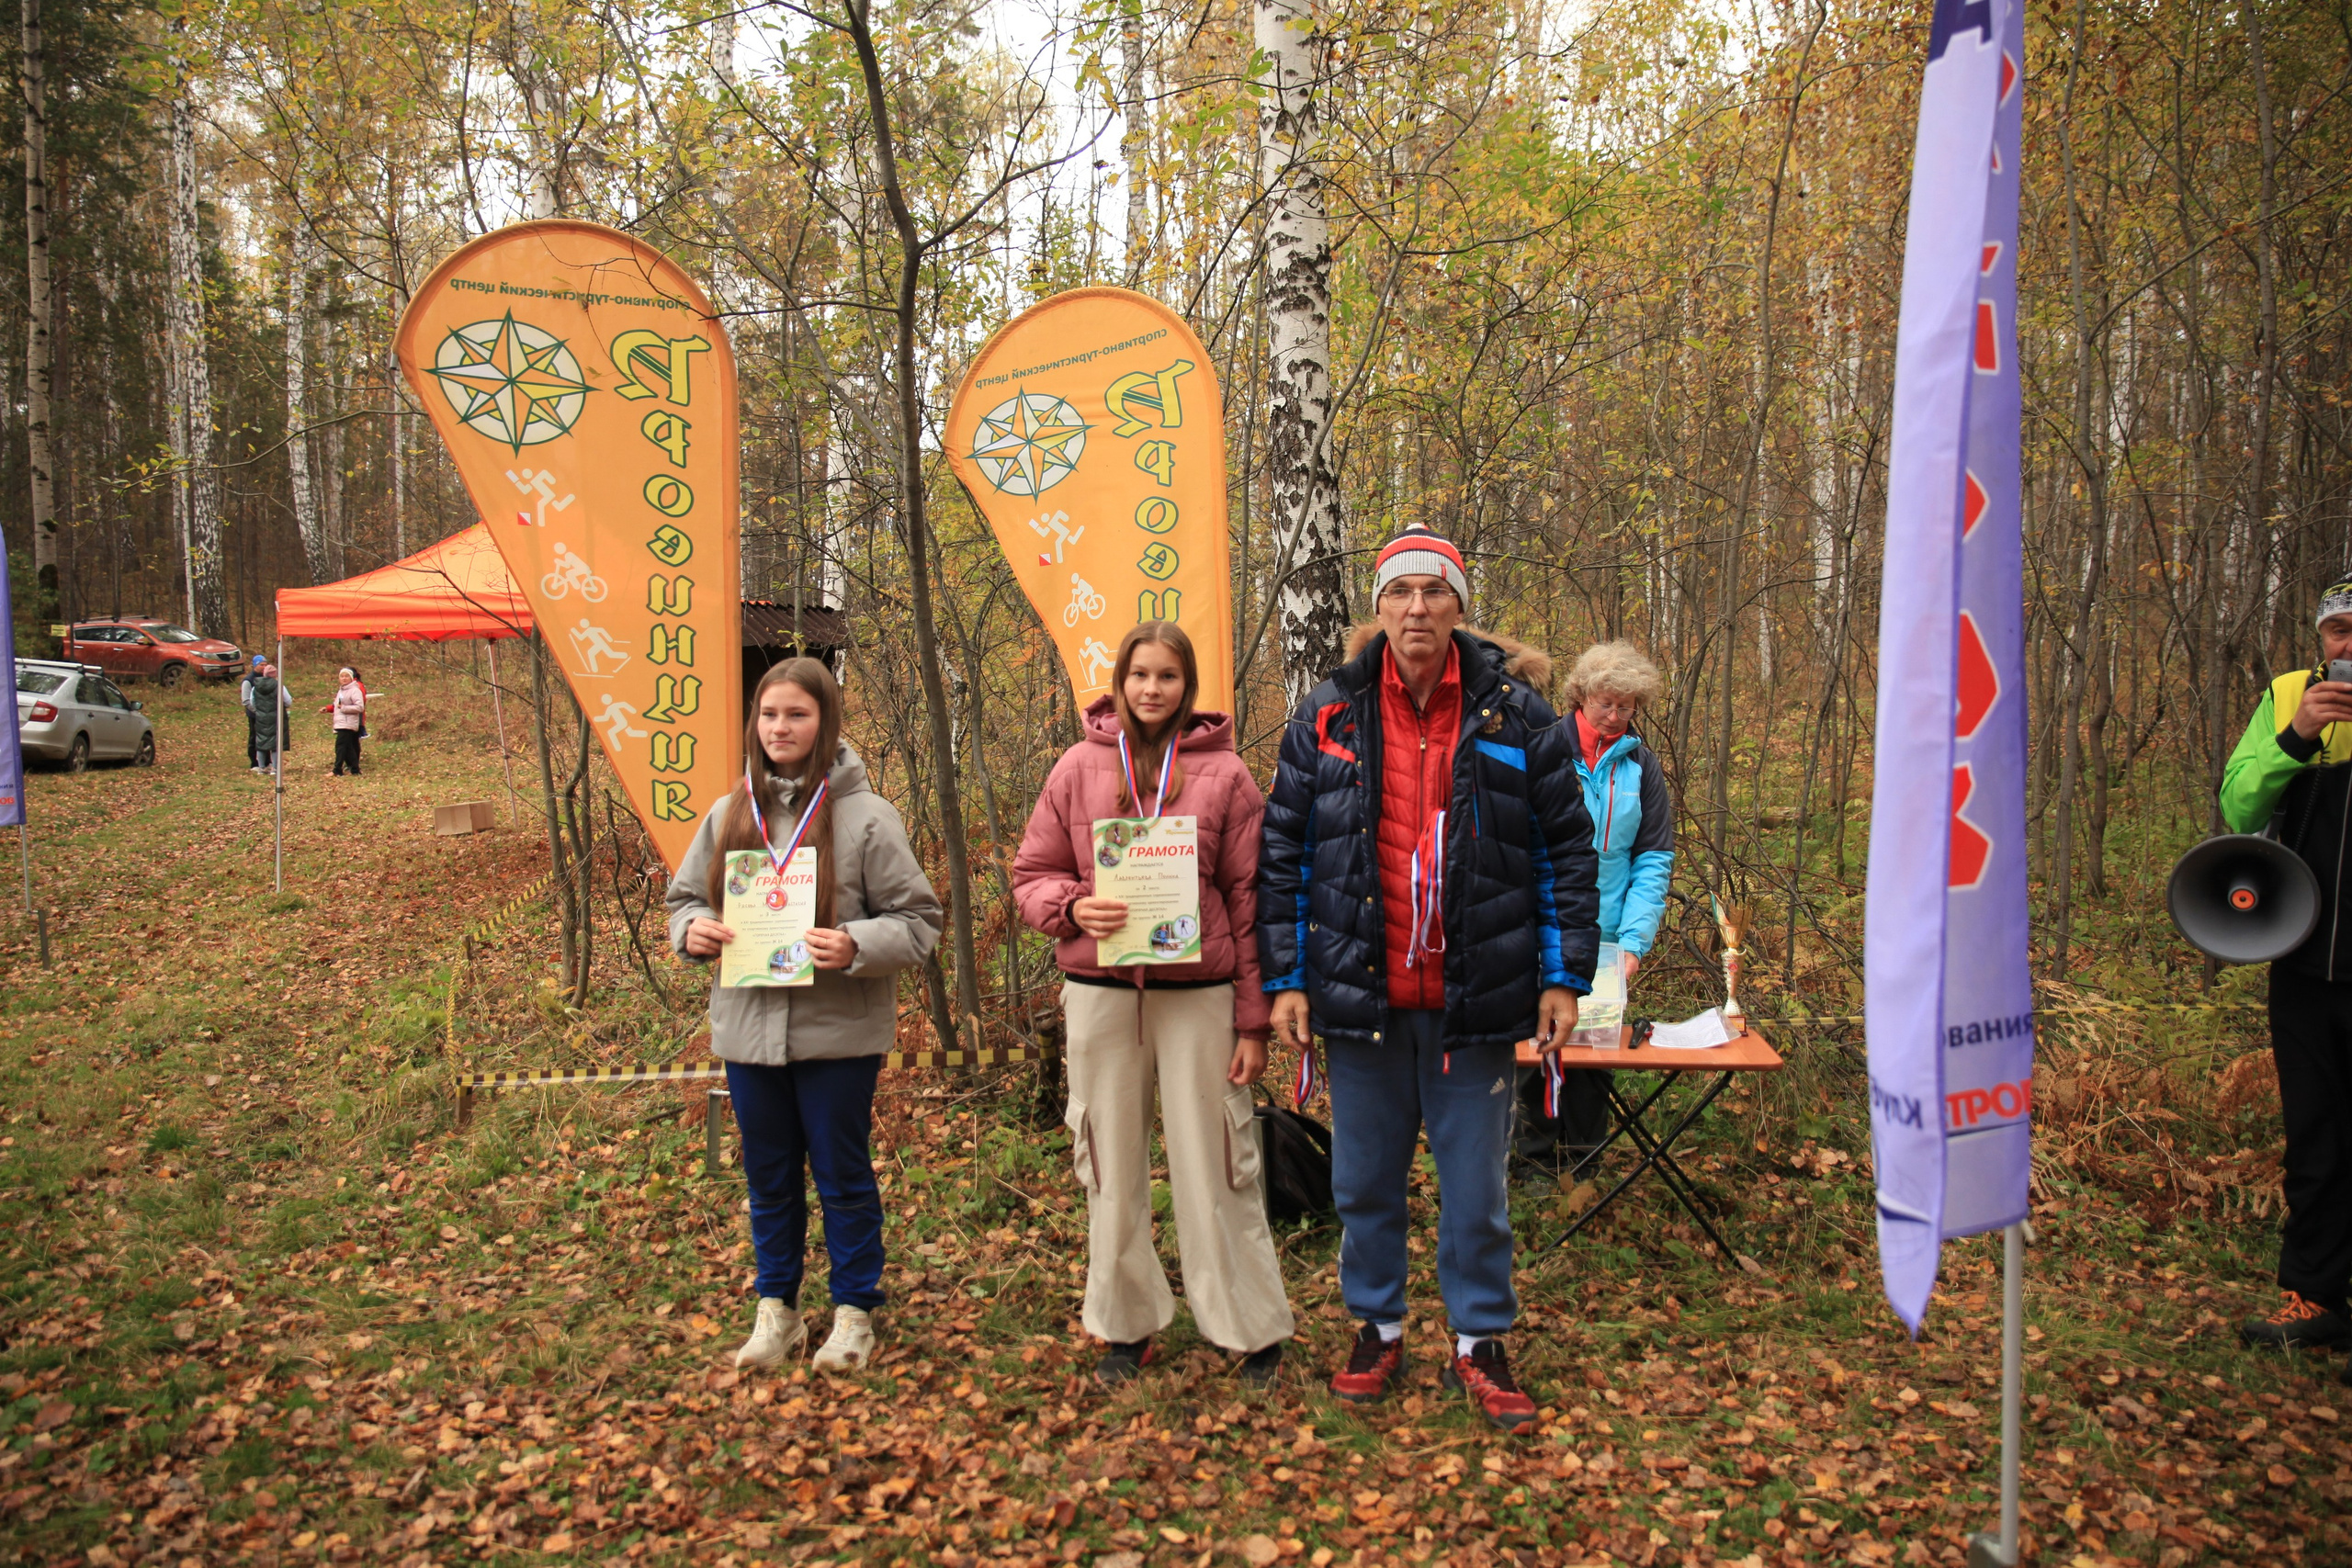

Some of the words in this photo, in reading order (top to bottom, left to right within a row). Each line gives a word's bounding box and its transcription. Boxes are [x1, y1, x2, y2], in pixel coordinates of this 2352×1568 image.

[1128, 845, 1194, 858] ГРАМОТА
[755, 874, 814, 887] ГРАМОТА
[1943, 1013, 2032, 1047] вания
[1945, 1077, 2031, 1129] ТРО
